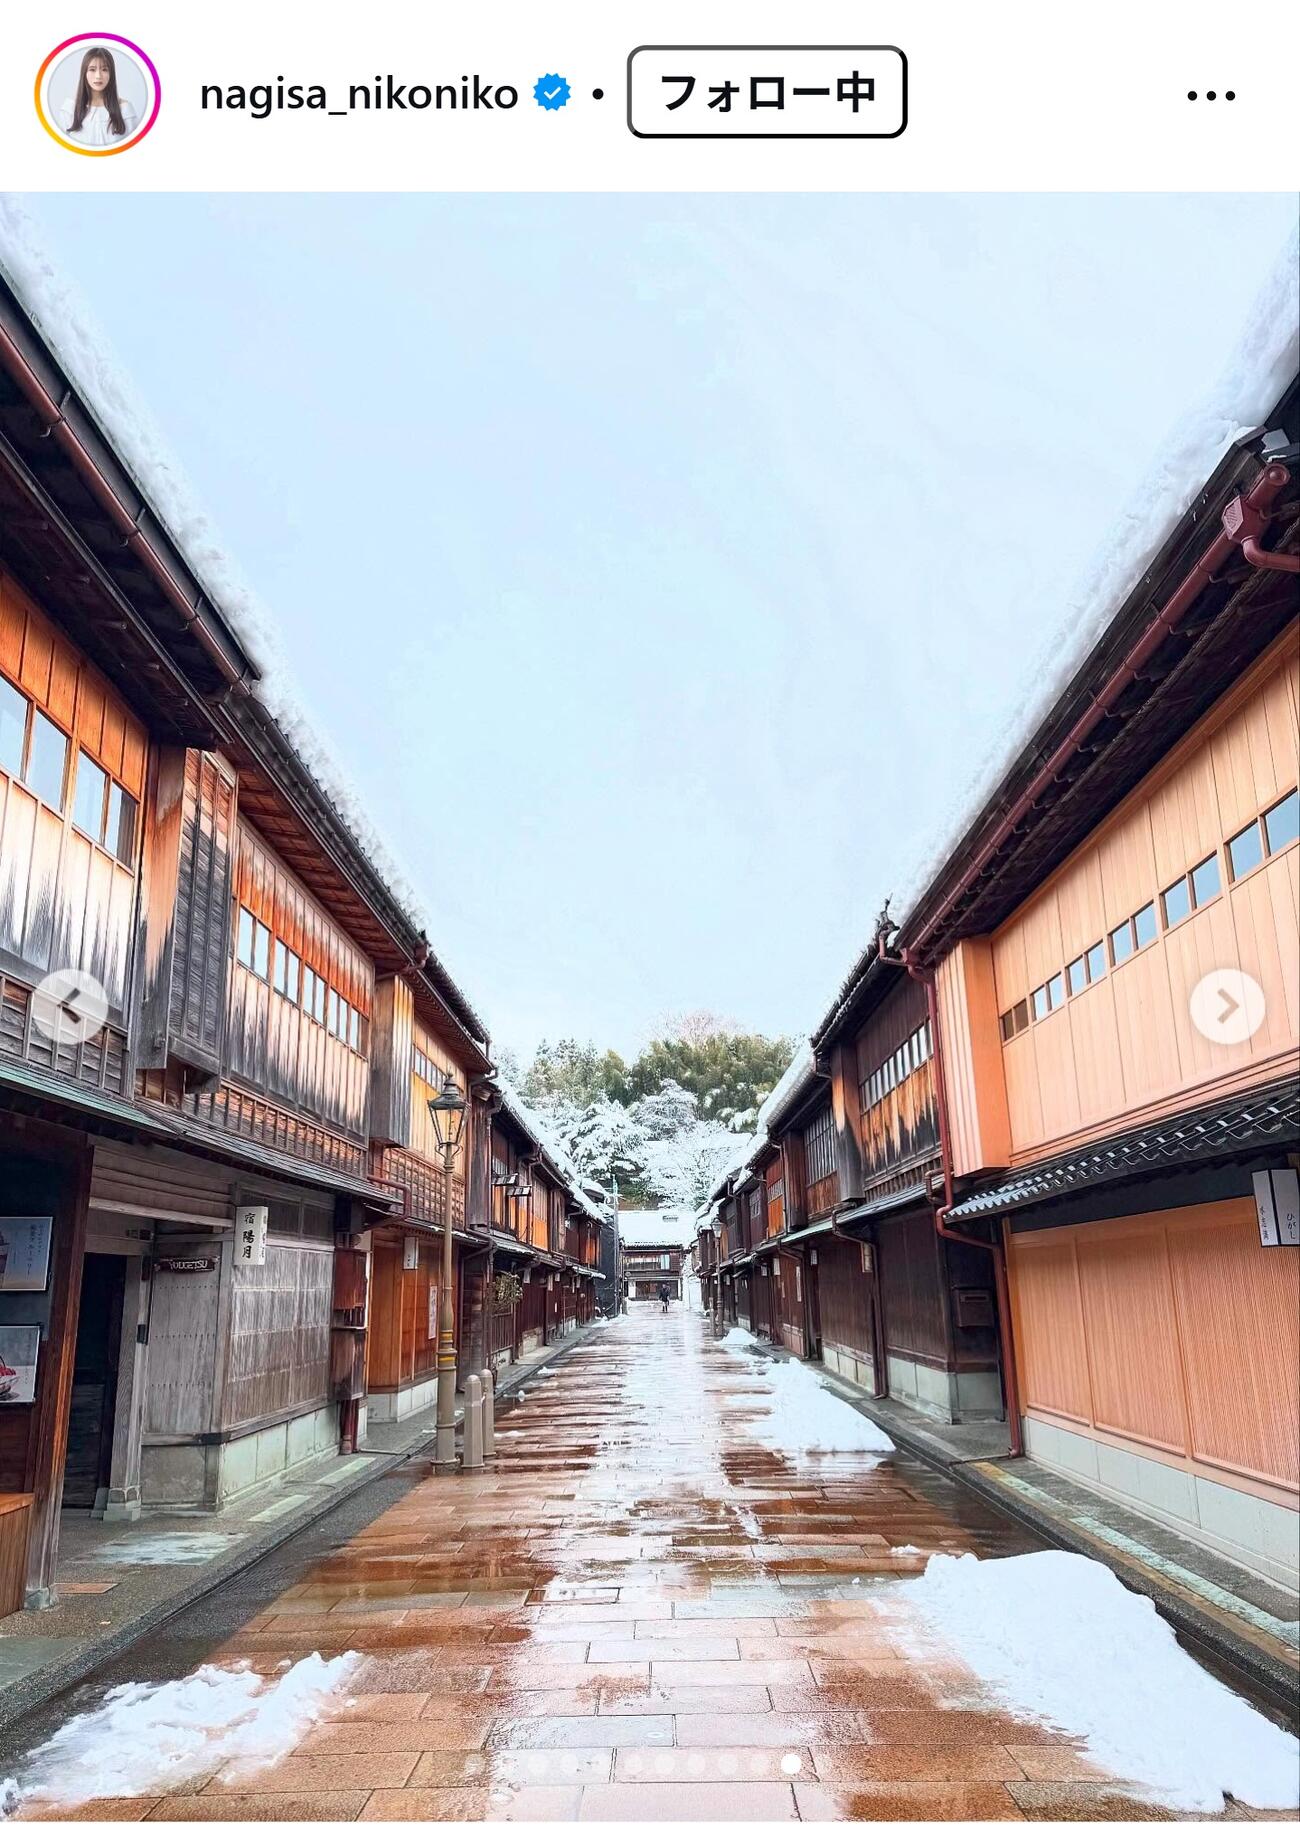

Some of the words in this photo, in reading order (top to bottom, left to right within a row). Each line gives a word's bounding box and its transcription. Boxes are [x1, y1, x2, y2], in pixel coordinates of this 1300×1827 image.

[242, 1212, 257, 1259] 宿陽月
[1286, 1213, 1297, 1240] ひがし
